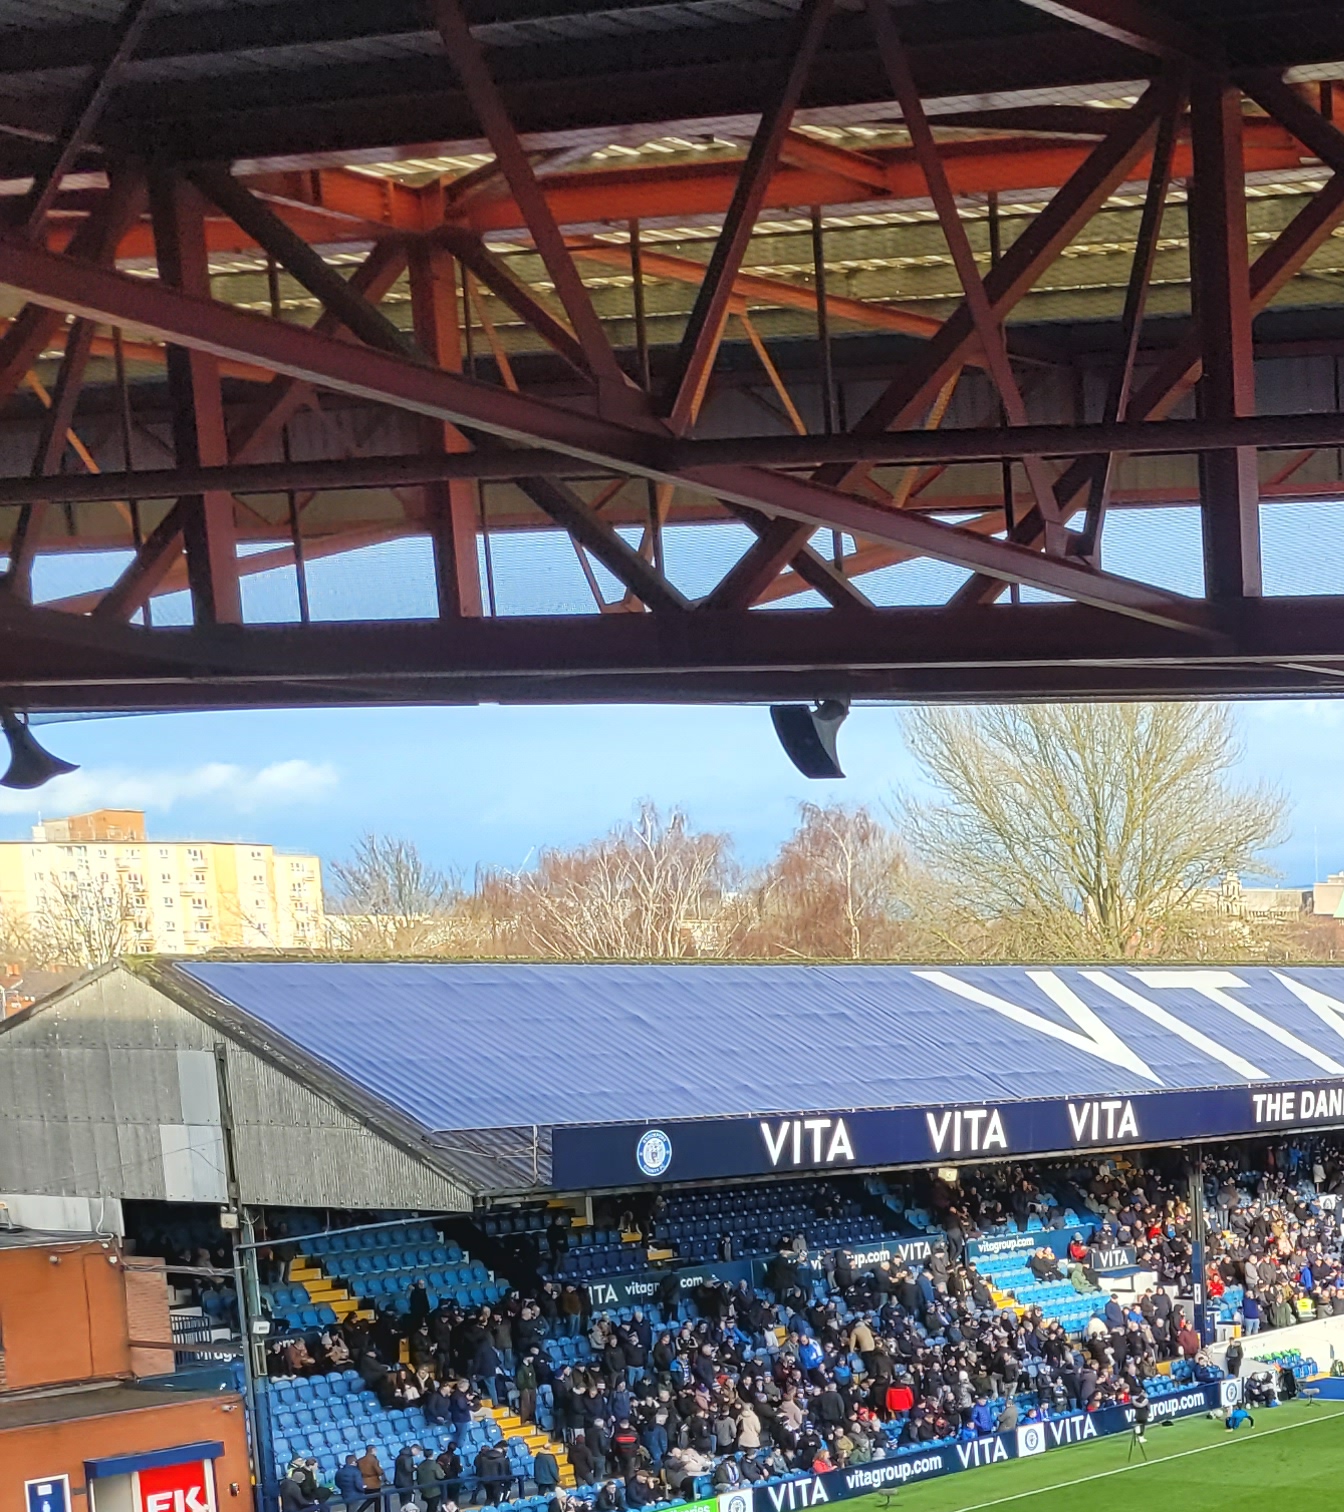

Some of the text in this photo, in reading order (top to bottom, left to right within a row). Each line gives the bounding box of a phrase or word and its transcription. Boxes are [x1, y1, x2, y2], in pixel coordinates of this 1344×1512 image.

[1068, 1100, 1139, 1143] VITA
[1253, 1093, 1294, 1124] THE
[761, 1118, 854, 1166] VITA
[926, 1108, 1008, 1153] VITA
[898, 1242, 933, 1262] VITA
[978, 1237, 1034, 1253] vitagroup.com
[1100, 1249, 1129, 1268] VITA
[588, 1283, 619, 1305] ITA
[1050, 1414, 1098, 1446] VITA
[957, 1434, 1008, 1469] VITA
[846, 1454, 942, 1489] vitagroup.com
[768, 1477, 829, 1512] VITA
